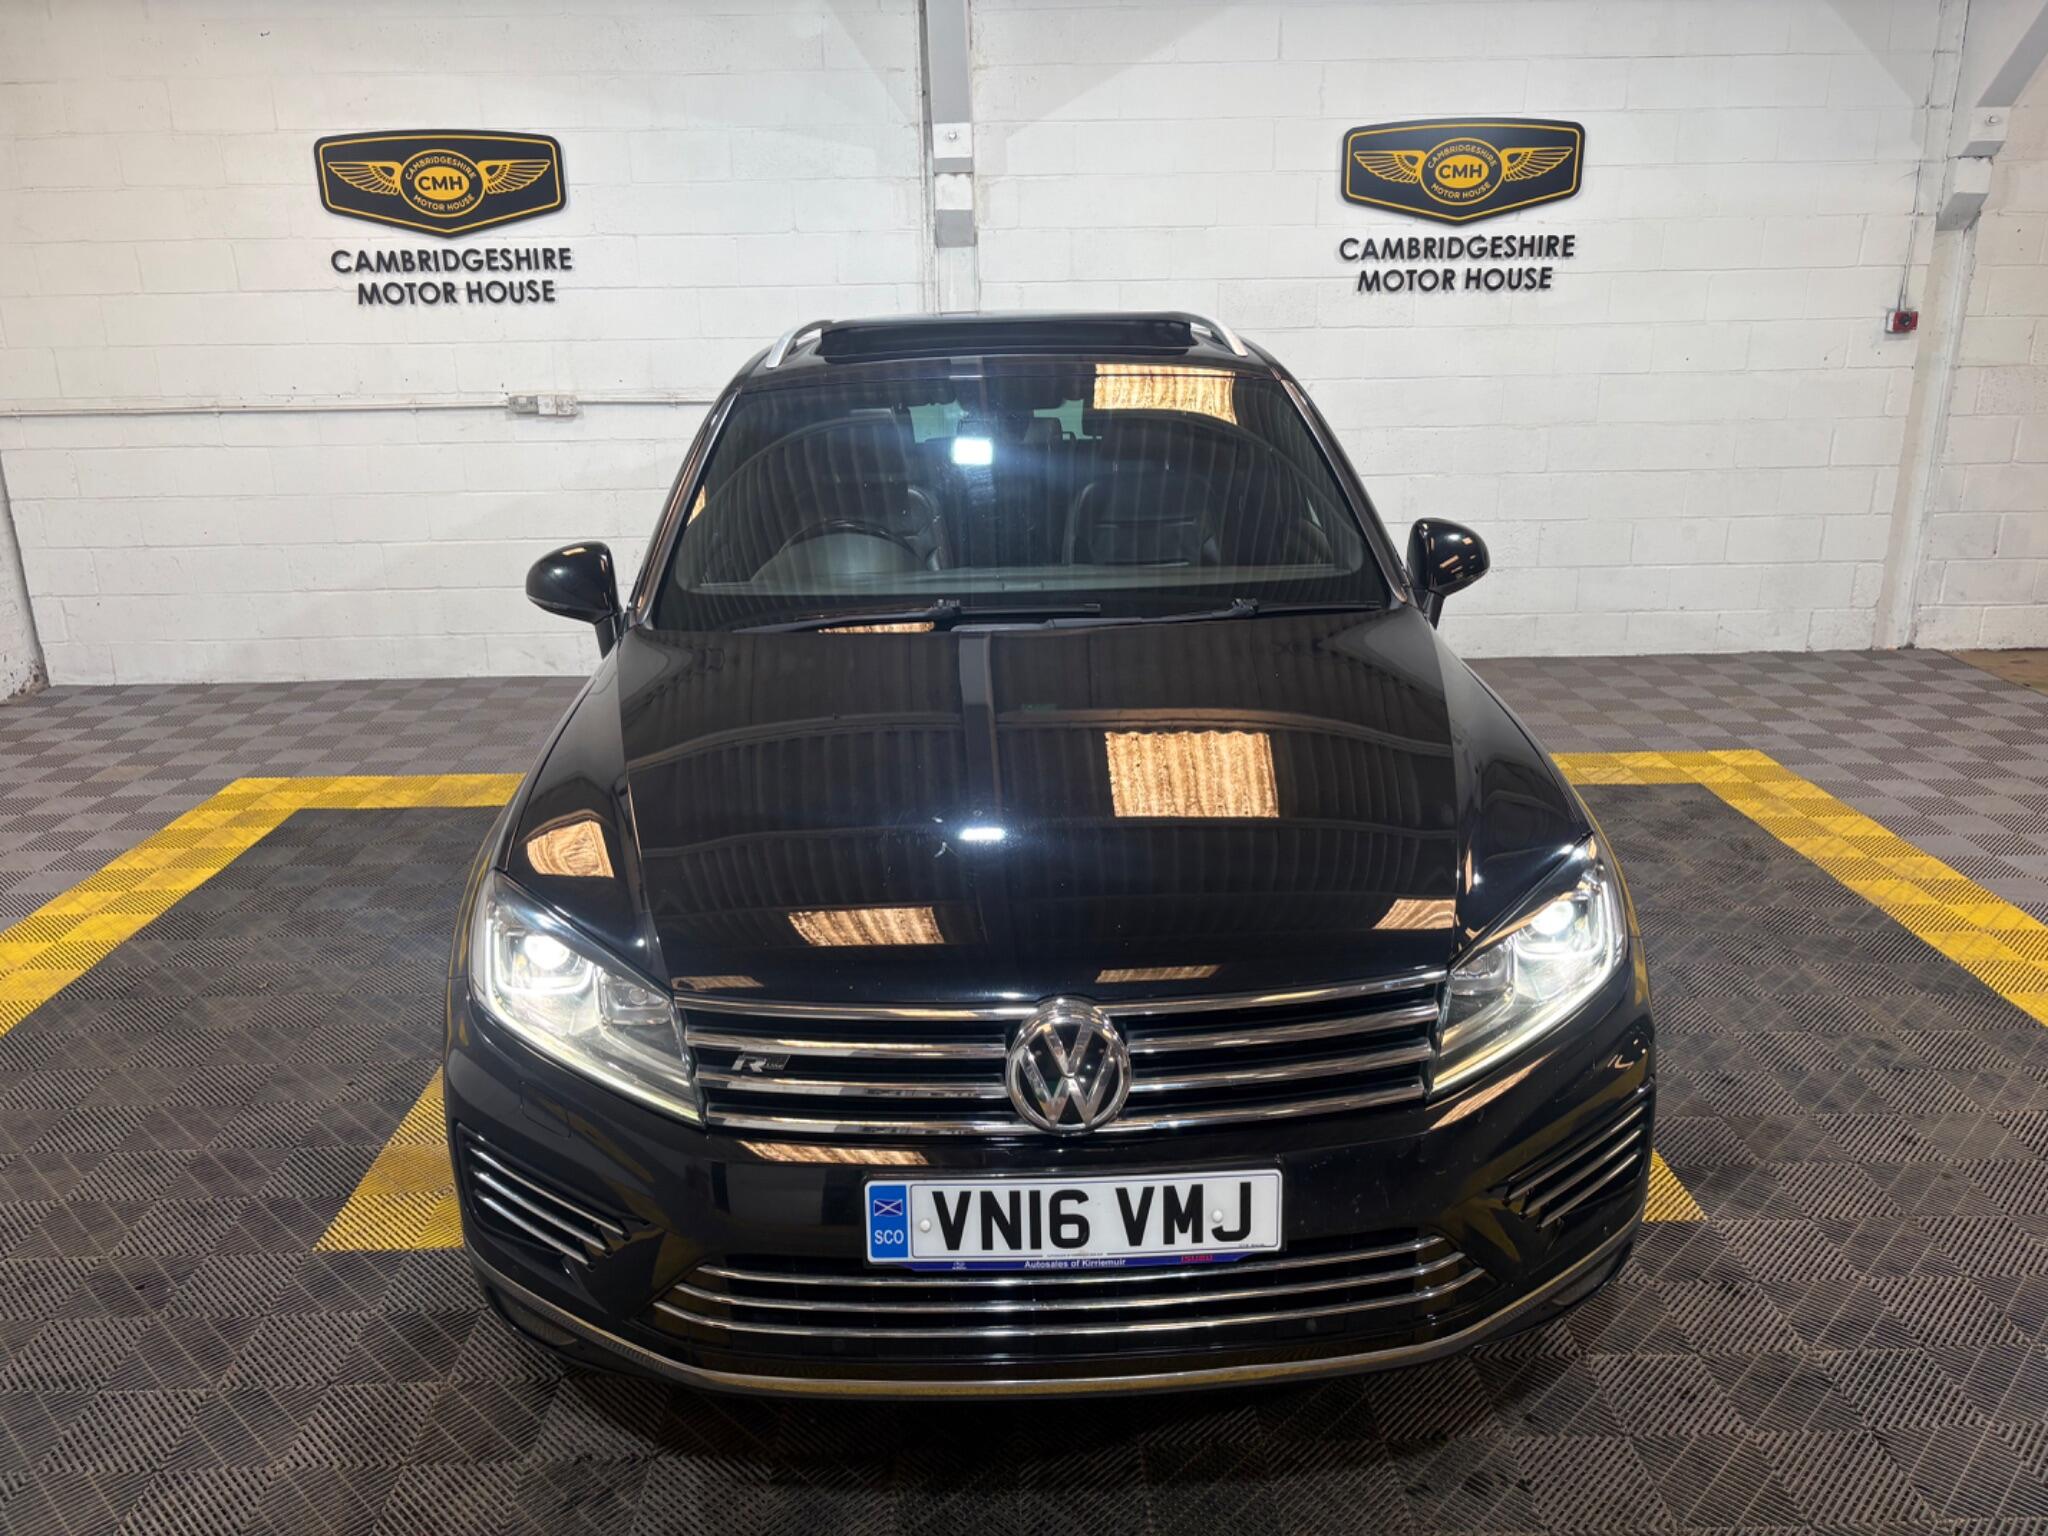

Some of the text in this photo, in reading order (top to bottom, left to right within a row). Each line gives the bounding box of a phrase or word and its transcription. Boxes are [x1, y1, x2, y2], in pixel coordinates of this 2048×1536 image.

[405, 156, 477, 180] CAMBRIDGESHIRE
[1427, 144, 1497, 168] CAMBRIDGESHIRE
[418, 175, 463, 191] CMH
[1439, 164, 1482, 179] CMH
[1431, 181, 1491, 199] MOTOR HOUSE
[413, 193, 475, 212] MOTOR HOUSE
[1338, 234, 1576, 260] CAMBRIDGESHIRE
[331, 247, 573, 274] CAMBRIDGESHIRE
[1357, 267, 1553, 292] MOTOR HOUSE
[357, 279, 556, 305] MOTOR HOUSE
[932, 1181, 1252, 1251] VN16 VMJ
[874, 1229, 904, 1245] SCO
[1024, 1259, 1069, 1269] Autosales
[1071, 1259, 1080, 1268] of
